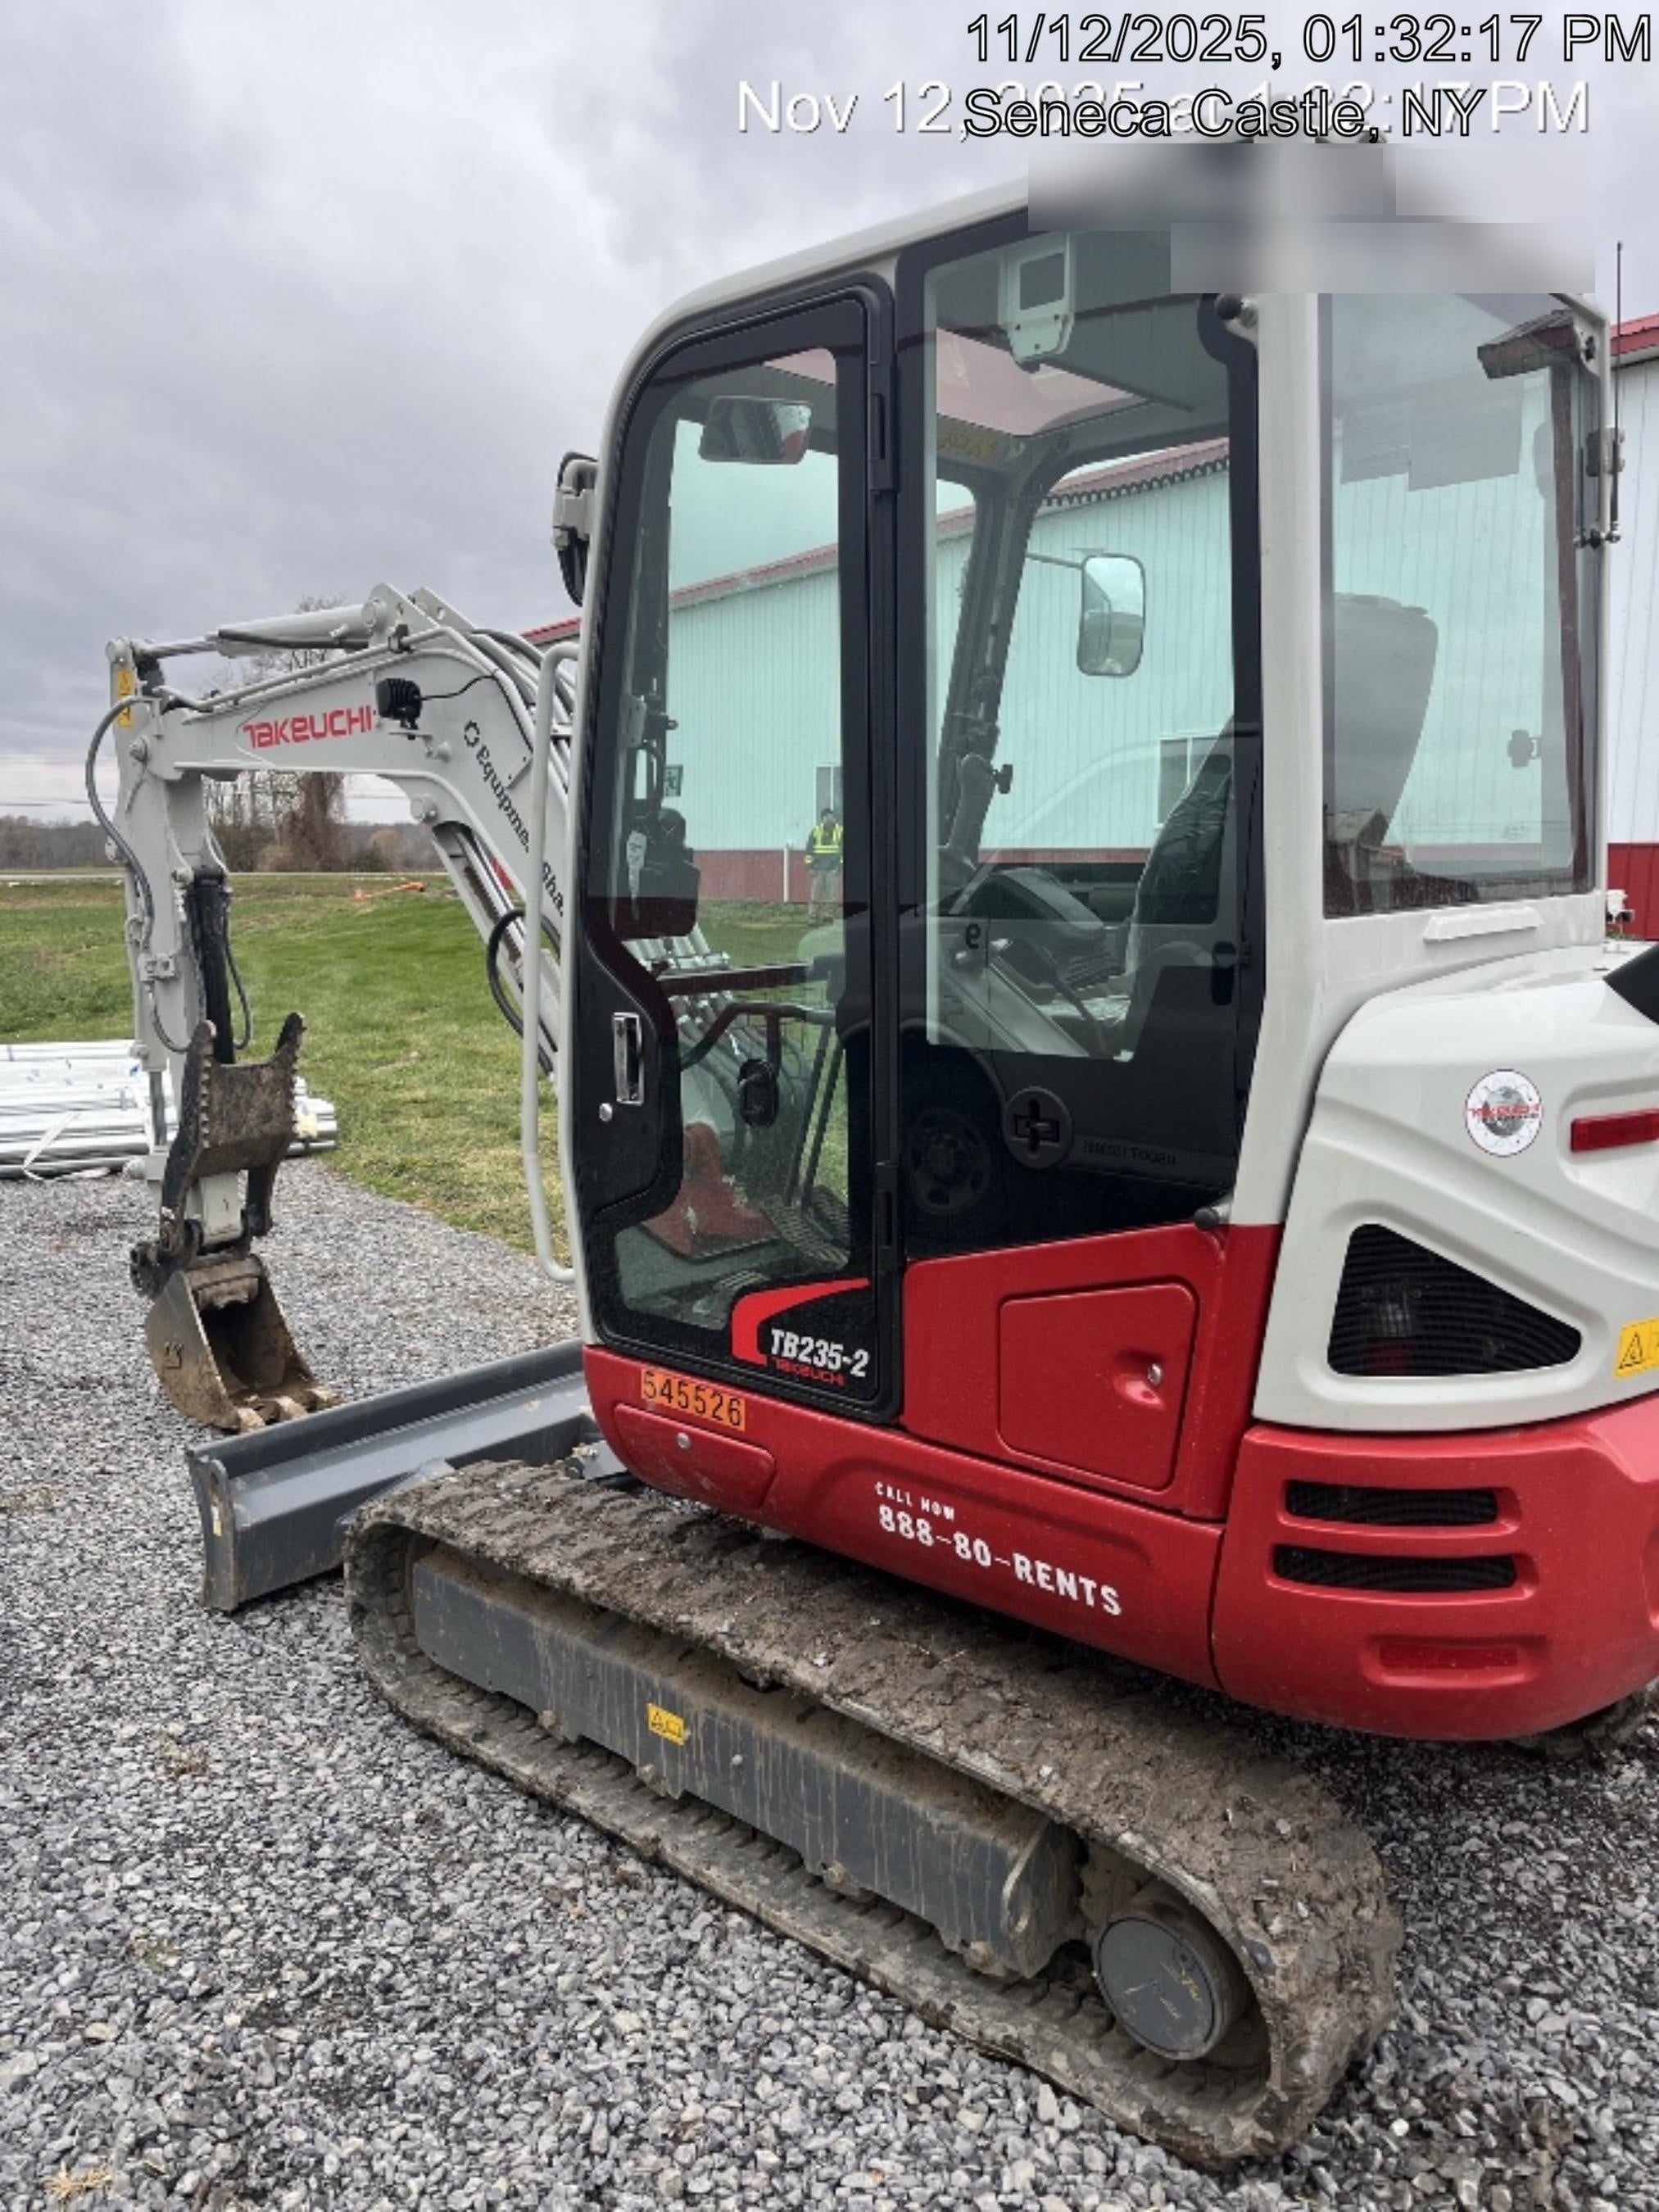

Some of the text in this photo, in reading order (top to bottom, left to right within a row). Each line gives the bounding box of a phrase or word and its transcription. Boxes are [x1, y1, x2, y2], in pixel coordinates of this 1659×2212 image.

[771, 1327, 869, 1378] TB235-2
[643, 1370, 741, 1426] 545526
[874, 1481, 955, 1521] CALL NOW
[878, 1504, 1122, 1616] 888-80-RENTS
